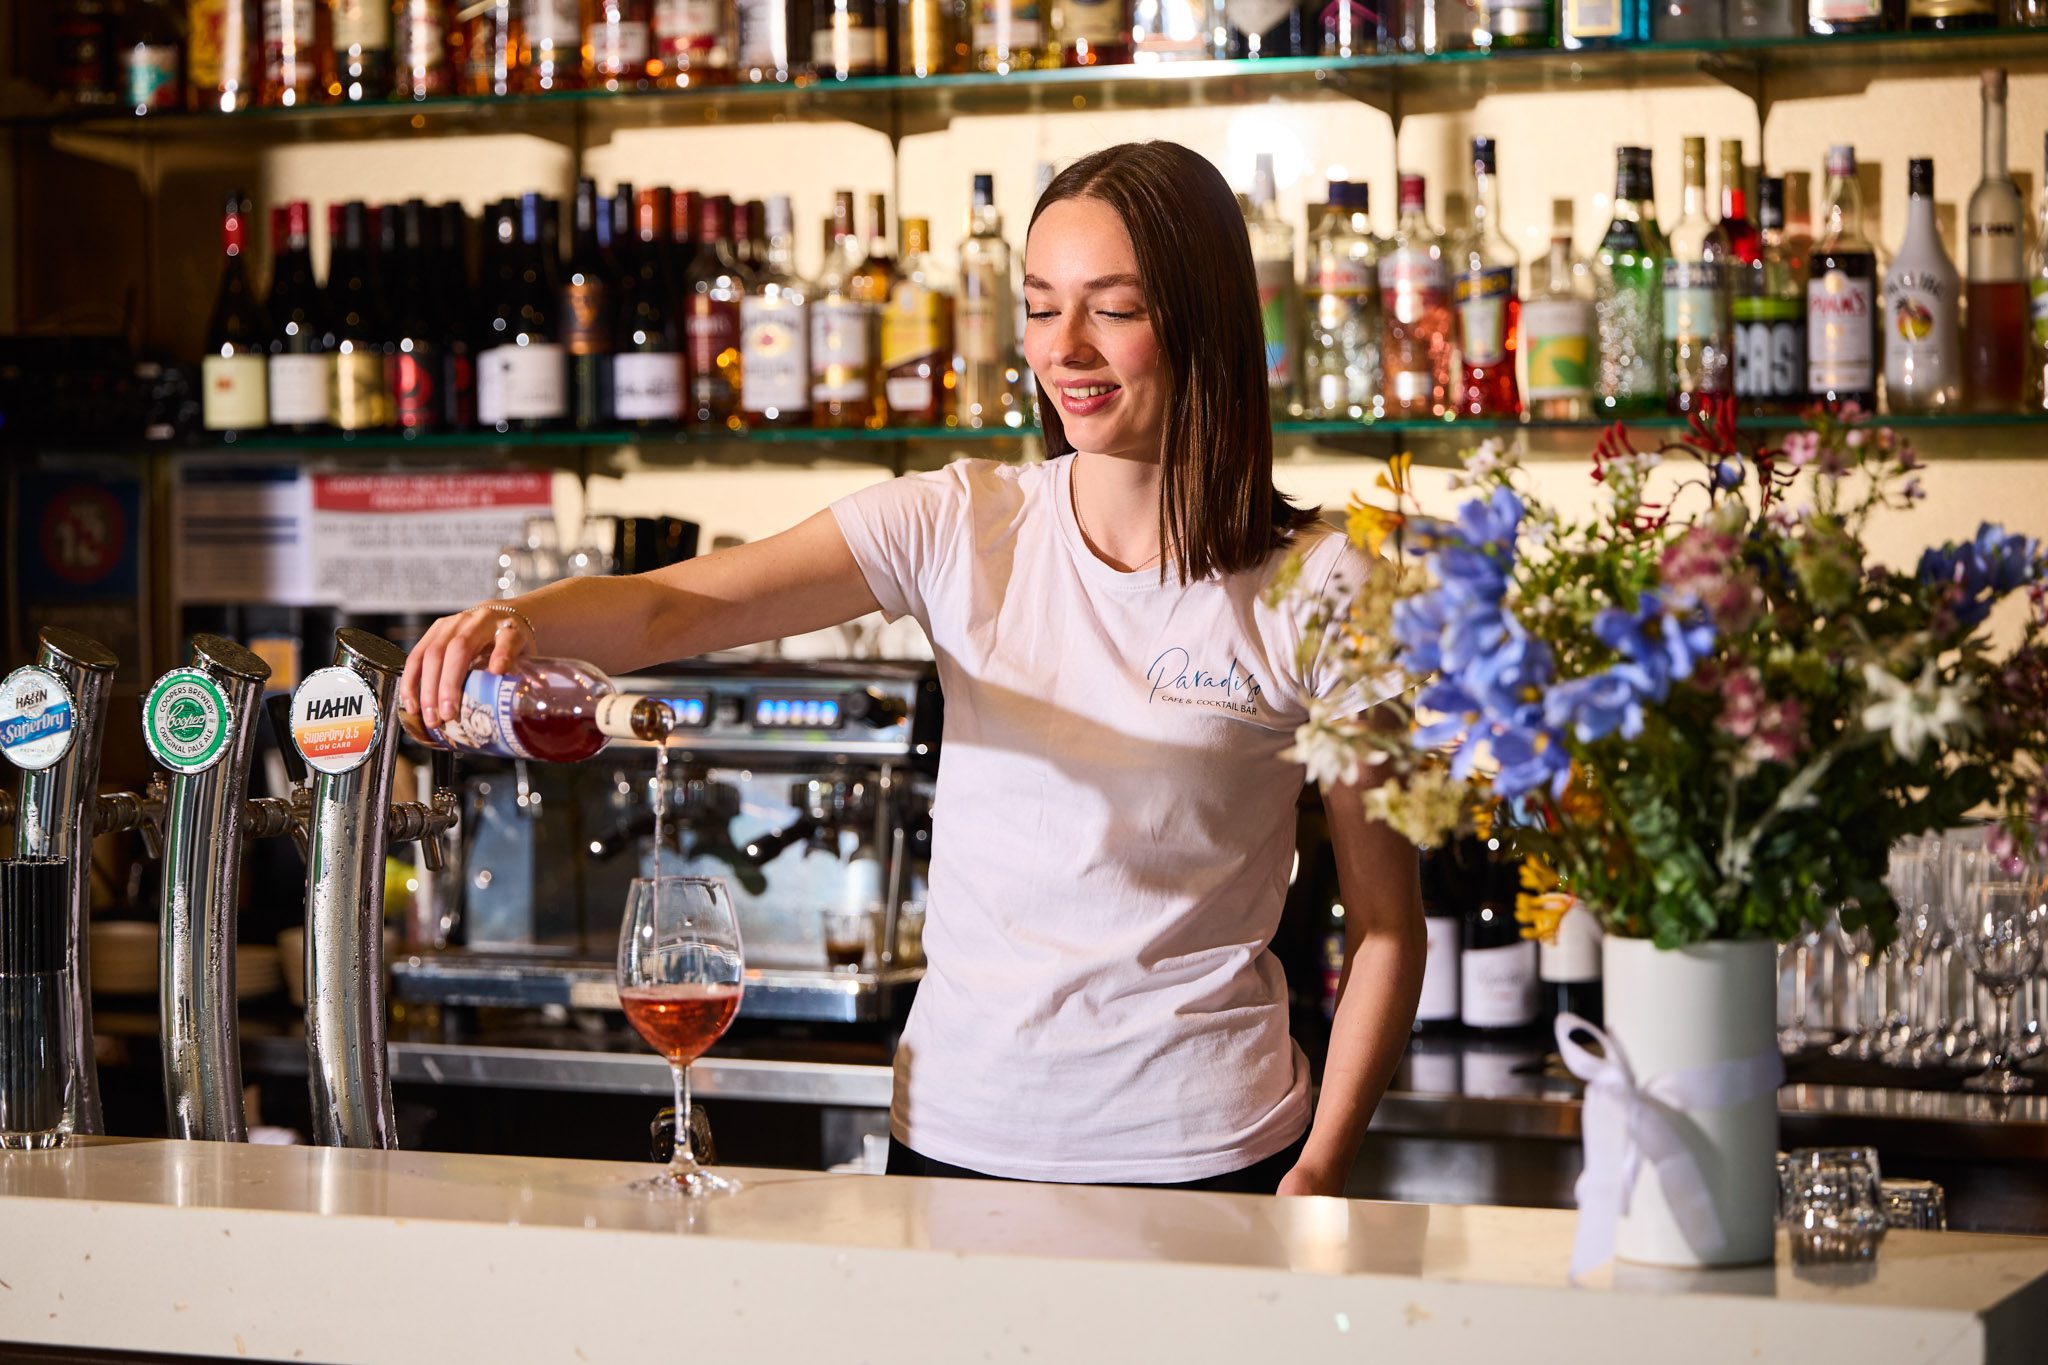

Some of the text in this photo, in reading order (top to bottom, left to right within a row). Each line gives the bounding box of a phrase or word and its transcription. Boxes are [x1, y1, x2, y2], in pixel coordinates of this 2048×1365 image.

[1147, 647, 1261, 704] Paradiso
[16, 689, 48, 709] HAHN
[160, 686, 215, 714] COOPERS BREWERY
[306, 695, 363, 720] HAHN
[1162, 695, 1183, 704] CAFE
[1196, 698, 1239, 711] COCKTAIL
[1240, 704, 1258, 716] BAR
[6, 712, 65, 744] SuperDry
[160, 726, 186, 753] ORIGINAL
[187, 743, 204, 754] PALE
[205, 728, 214, 743] ALE
[303, 728, 345, 744] SuperDry
[315, 741, 351, 751] LOW CARB
